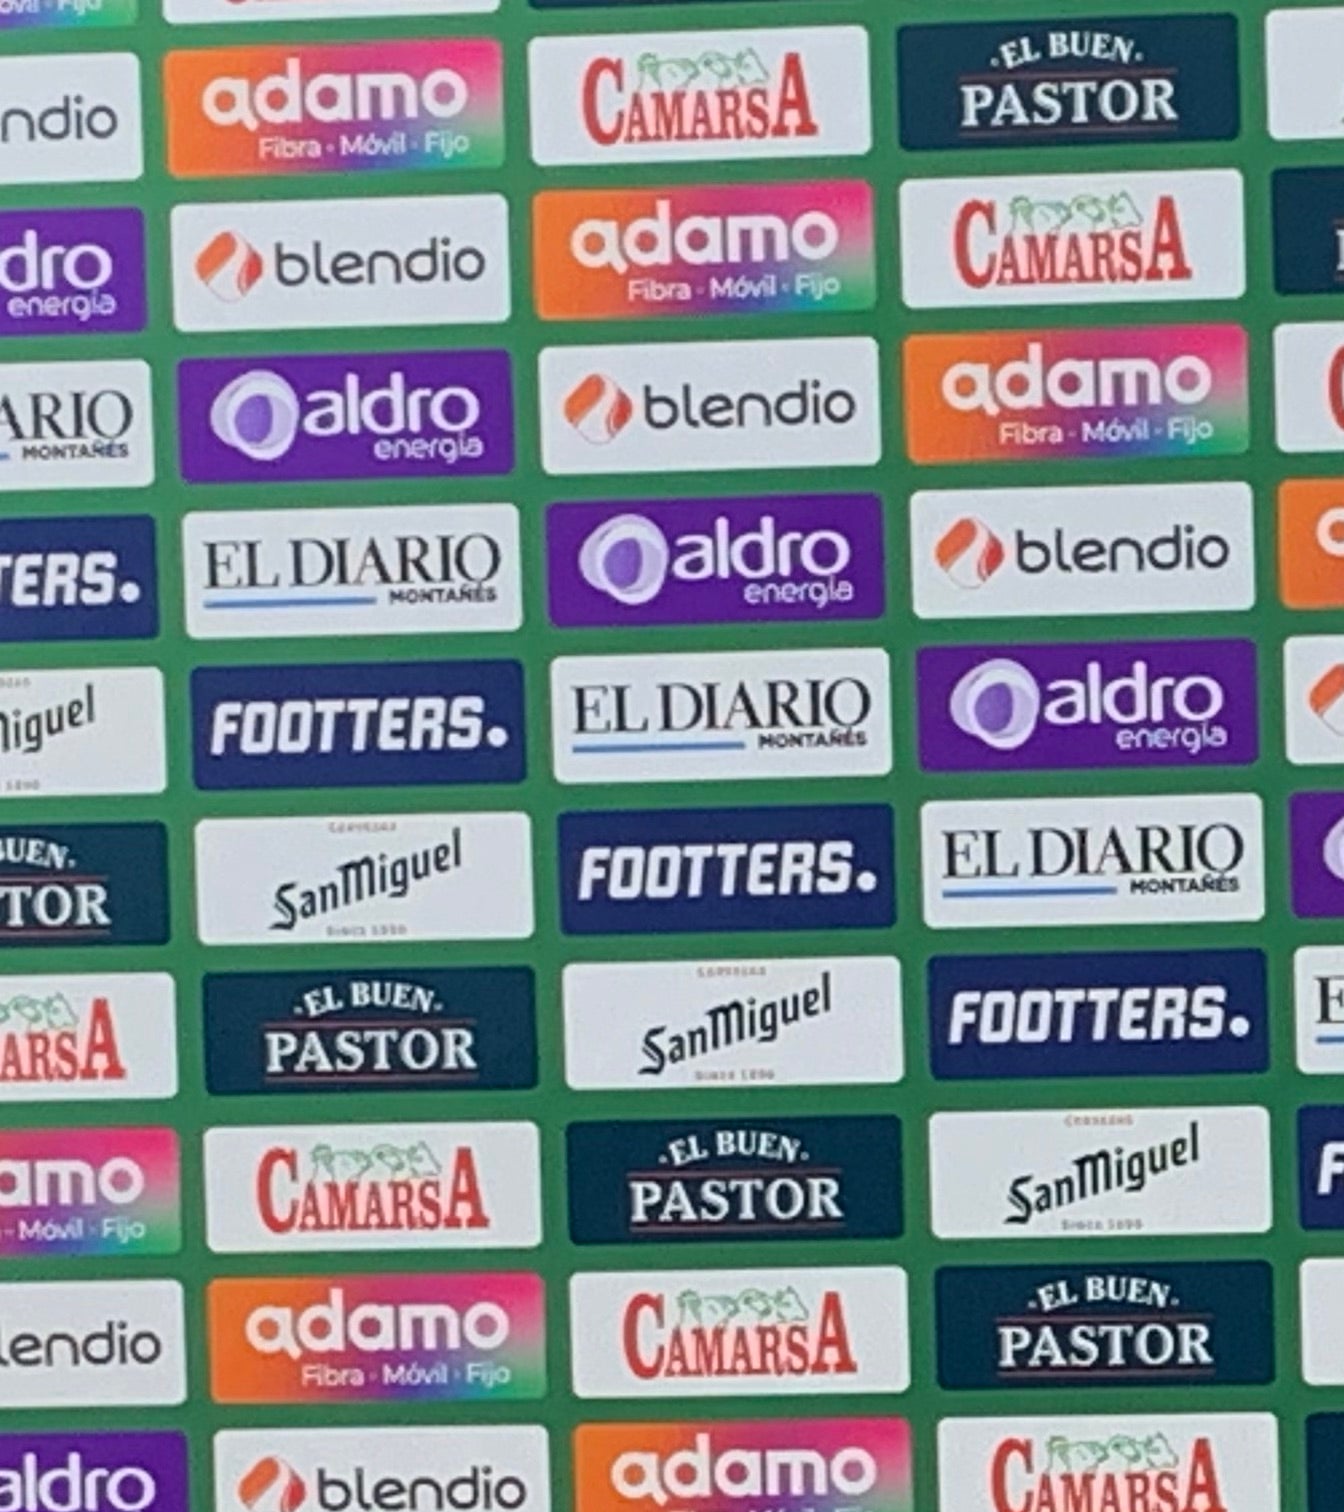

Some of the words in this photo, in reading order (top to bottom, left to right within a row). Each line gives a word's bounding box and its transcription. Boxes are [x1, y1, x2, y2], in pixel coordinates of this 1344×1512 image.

[999, 36, 1041, 69] EL
[1048, 30, 1134, 64] BUEN
[201, 57, 467, 132] adamo
[960, 78, 1178, 127] PASTOR
[258, 135, 323, 159] Fibra
[339, 130, 407, 156] Móvil
[424, 130, 467, 159] Fijo
[570, 199, 838, 274] adamo
[274, 236, 486, 287] blendio
[627, 277, 693, 302] Fibra
[708, 273, 777, 300] Móvil
[794, 274, 840, 301] Fijo
[302, 371, 480, 436] aldro
[203, 540, 280, 589] EL
[289, 534, 502, 587] DIARIO
[671, 515, 850, 580] aldro
[573, 685, 649, 735] EL
[657, 677, 872, 732] DIARIO
[303, 986, 344, 1017] EL
[350, 981, 435, 1013] BUEN
[265, 1028, 478, 1073] PASTOR
[668, 1135, 709, 1166] EL
[716, 1130, 804, 1163] BUEN
[629, 1177, 844, 1223] PASTOR
[244, 1287, 509, 1360] adamo
[301, 1363, 366, 1387] Fibra
[381, 1361, 449, 1386] Móvil
[466, 1362, 510, 1389] Fijo
[317, 1465, 527, 1512] blendio
